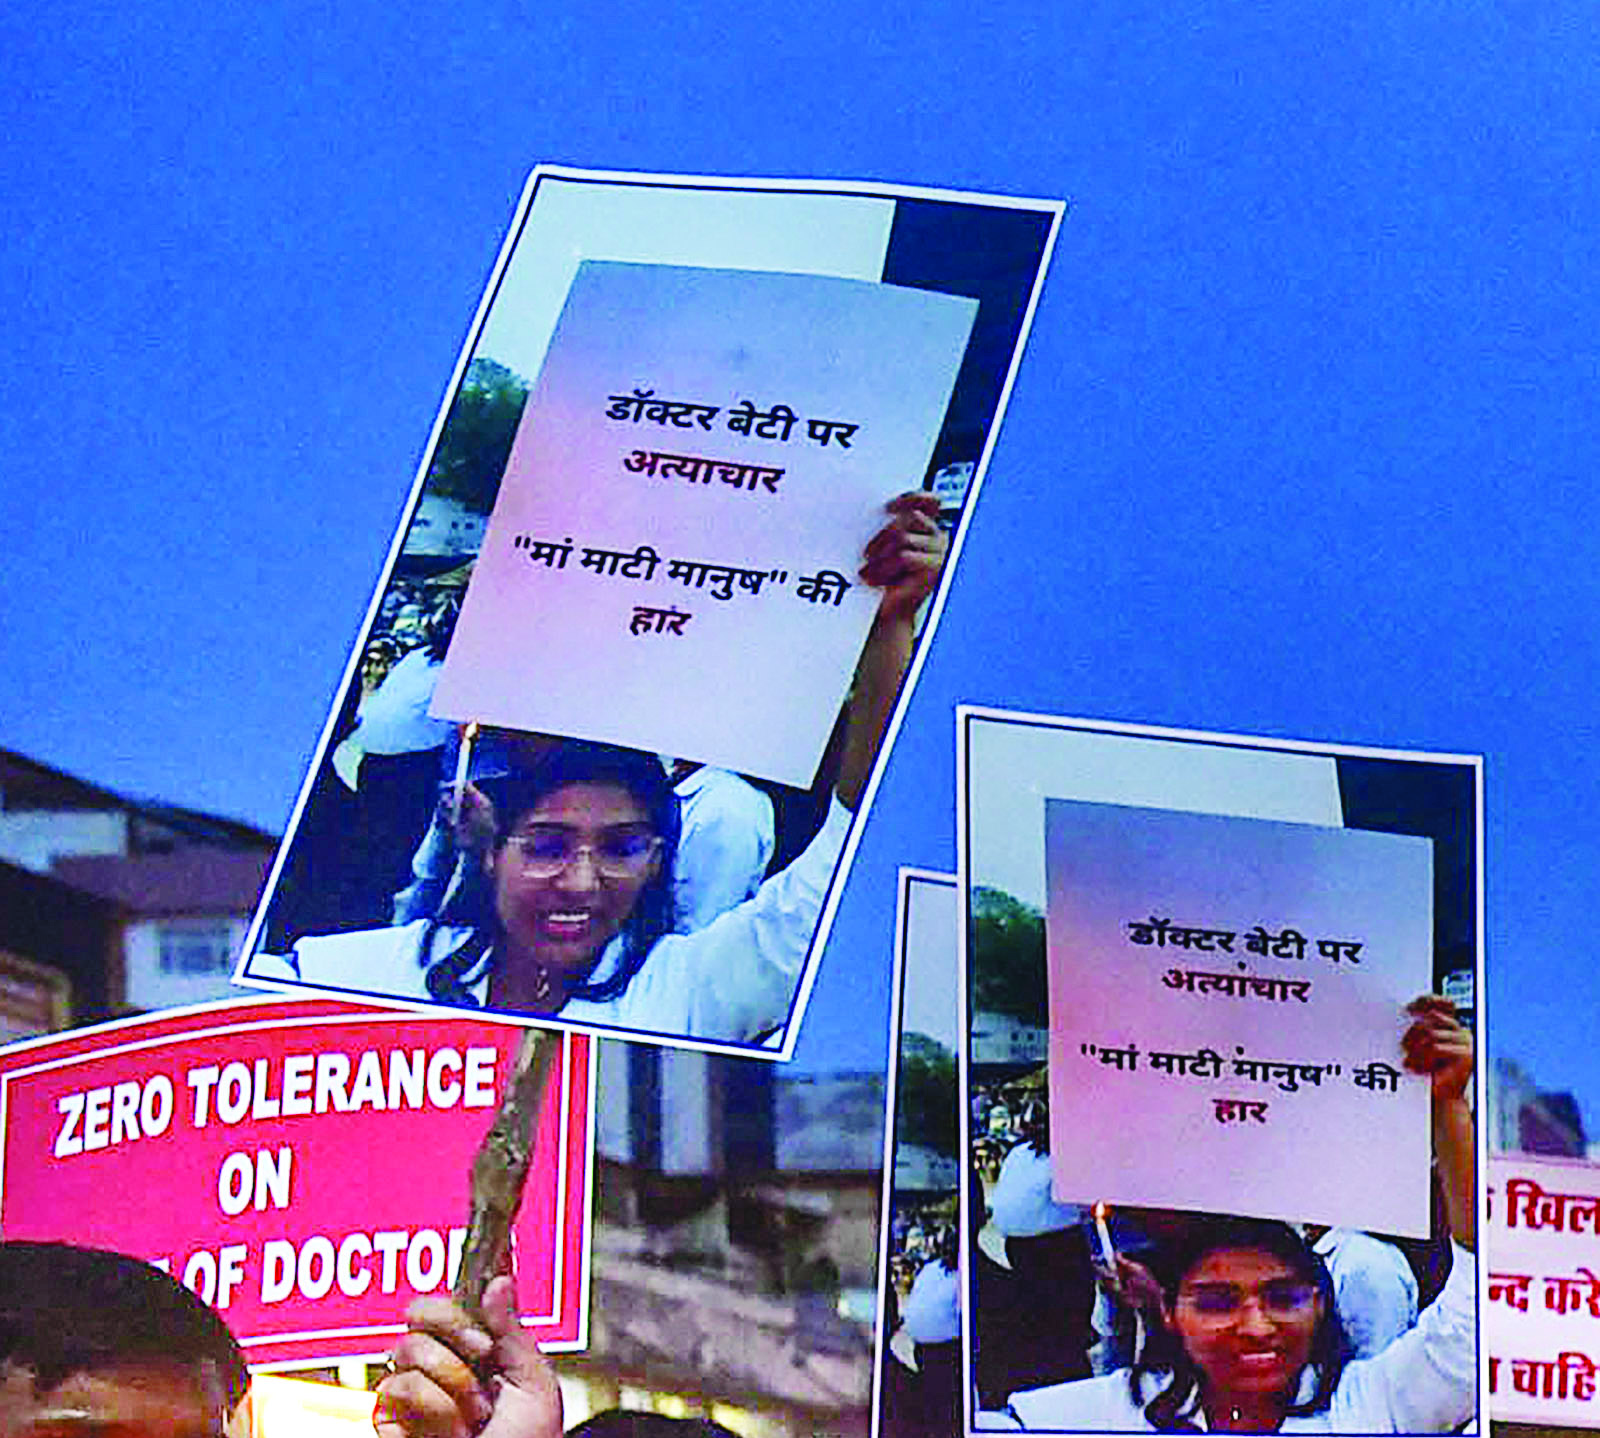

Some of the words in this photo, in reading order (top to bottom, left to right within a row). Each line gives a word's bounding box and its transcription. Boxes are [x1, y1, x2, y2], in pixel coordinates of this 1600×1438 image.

[606, 389, 720, 430] डॉक्टर
[728, 401, 799, 441] बेटी
[807, 419, 859, 448] पर
[624, 450, 785, 493] अत्याचार
[581, 546, 661, 580] माटी
[668, 560, 787, 600] मानुष"
[797, 570, 852, 606] की
[1128, 916, 1236, 953] डॉक्टर
[1244, 927, 1307, 960] बेटी
[1316, 940, 1363, 964] पर
[1149, 1049, 1223, 1079] माटी
[1353, 1063, 1400, 1092] की
[54, 1075, 173, 1158] ZERO
[187, 1046, 497, 1128] TOLERANCE
[1212, 1099, 1268, 1124] हार
[218, 1146, 292, 1216] ON
[184, 1244, 247, 1309] OF
